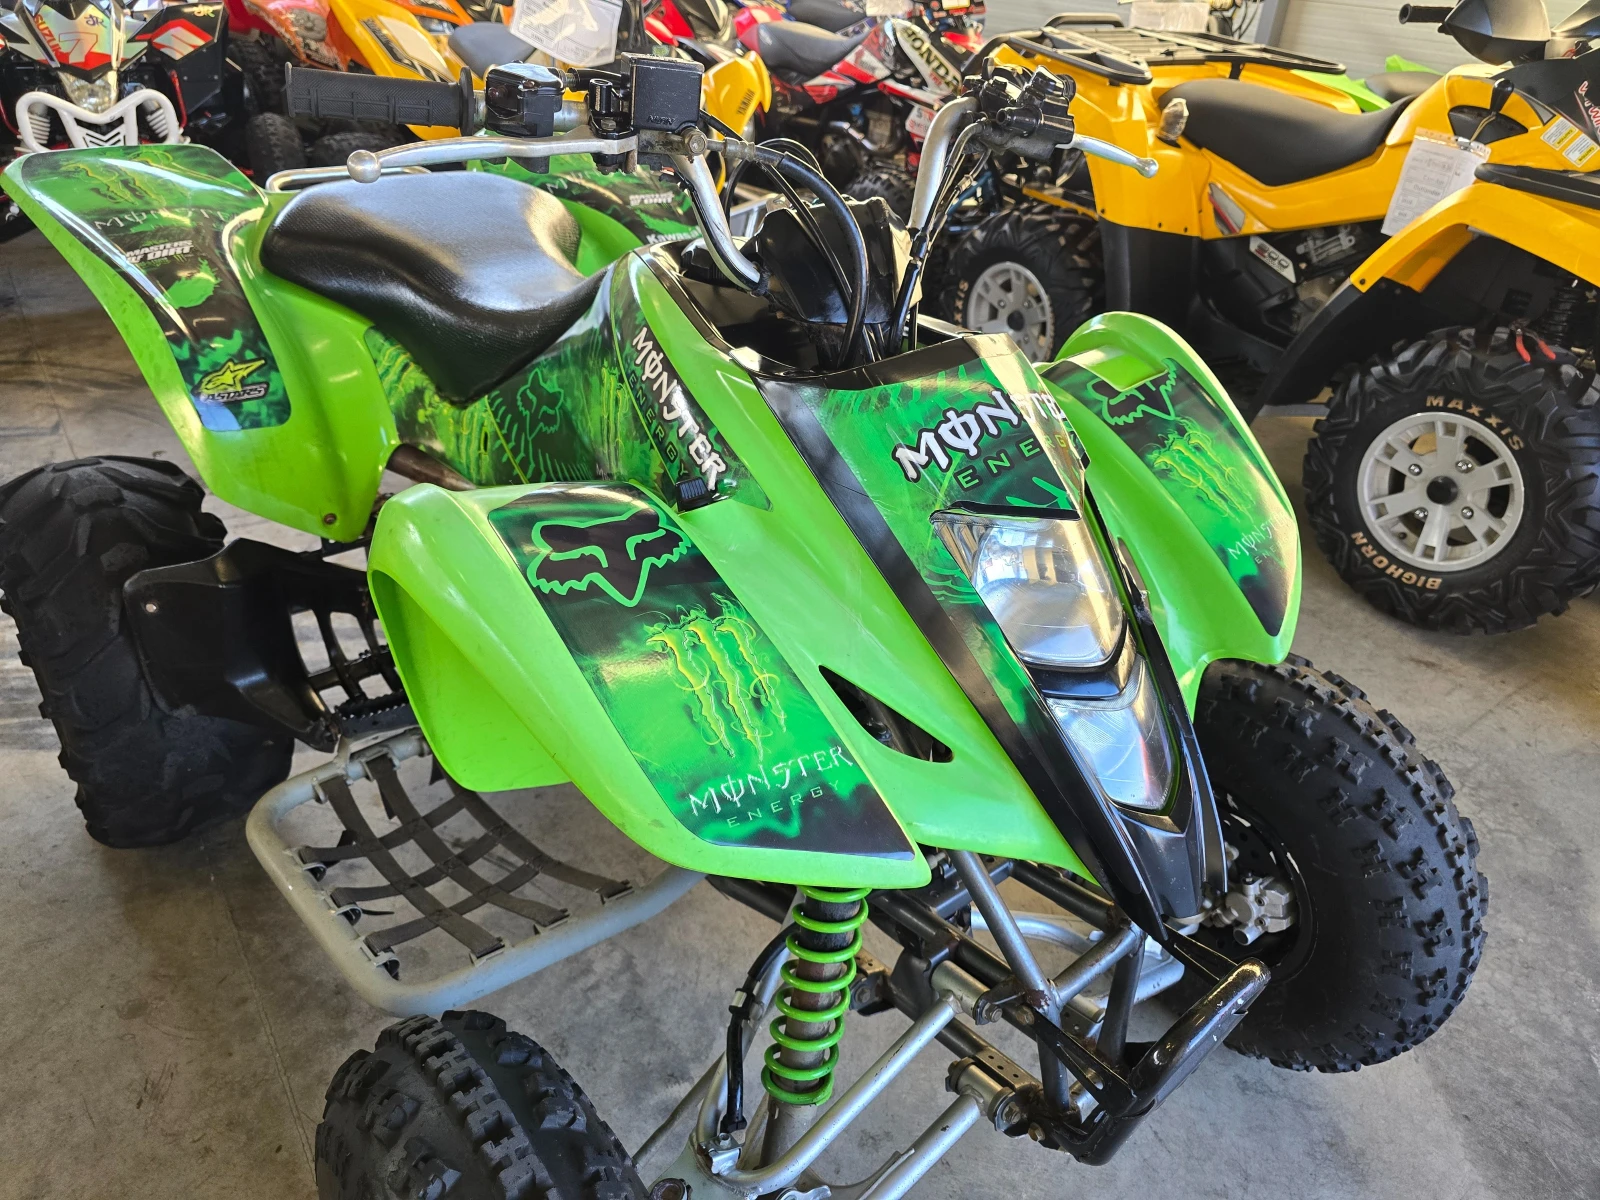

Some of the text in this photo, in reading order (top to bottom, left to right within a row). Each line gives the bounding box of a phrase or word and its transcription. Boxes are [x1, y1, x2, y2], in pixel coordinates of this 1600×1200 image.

[34, 13, 67, 58] SUZUK
[59, 32, 98, 64] 7
[902, 26, 962, 95] HONDA
[94, 207, 233, 230] MONST
[646, 226, 702, 245] Kawasa
[147, 245, 194, 261] DIRT
[628, 372, 688, 476] ENERGY
[632, 326, 727, 492] MONSTER
[893, 389, 1068, 481] MONSTE
[1425, 395, 1525, 451] MAXXIS
[1227, 512, 1290, 560] MONSTE
[1351, 531, 1443, 590] BIGHORN
[687, 745, 853, 817] MONSTER
[726, 780, 839, 828] ENERGY
